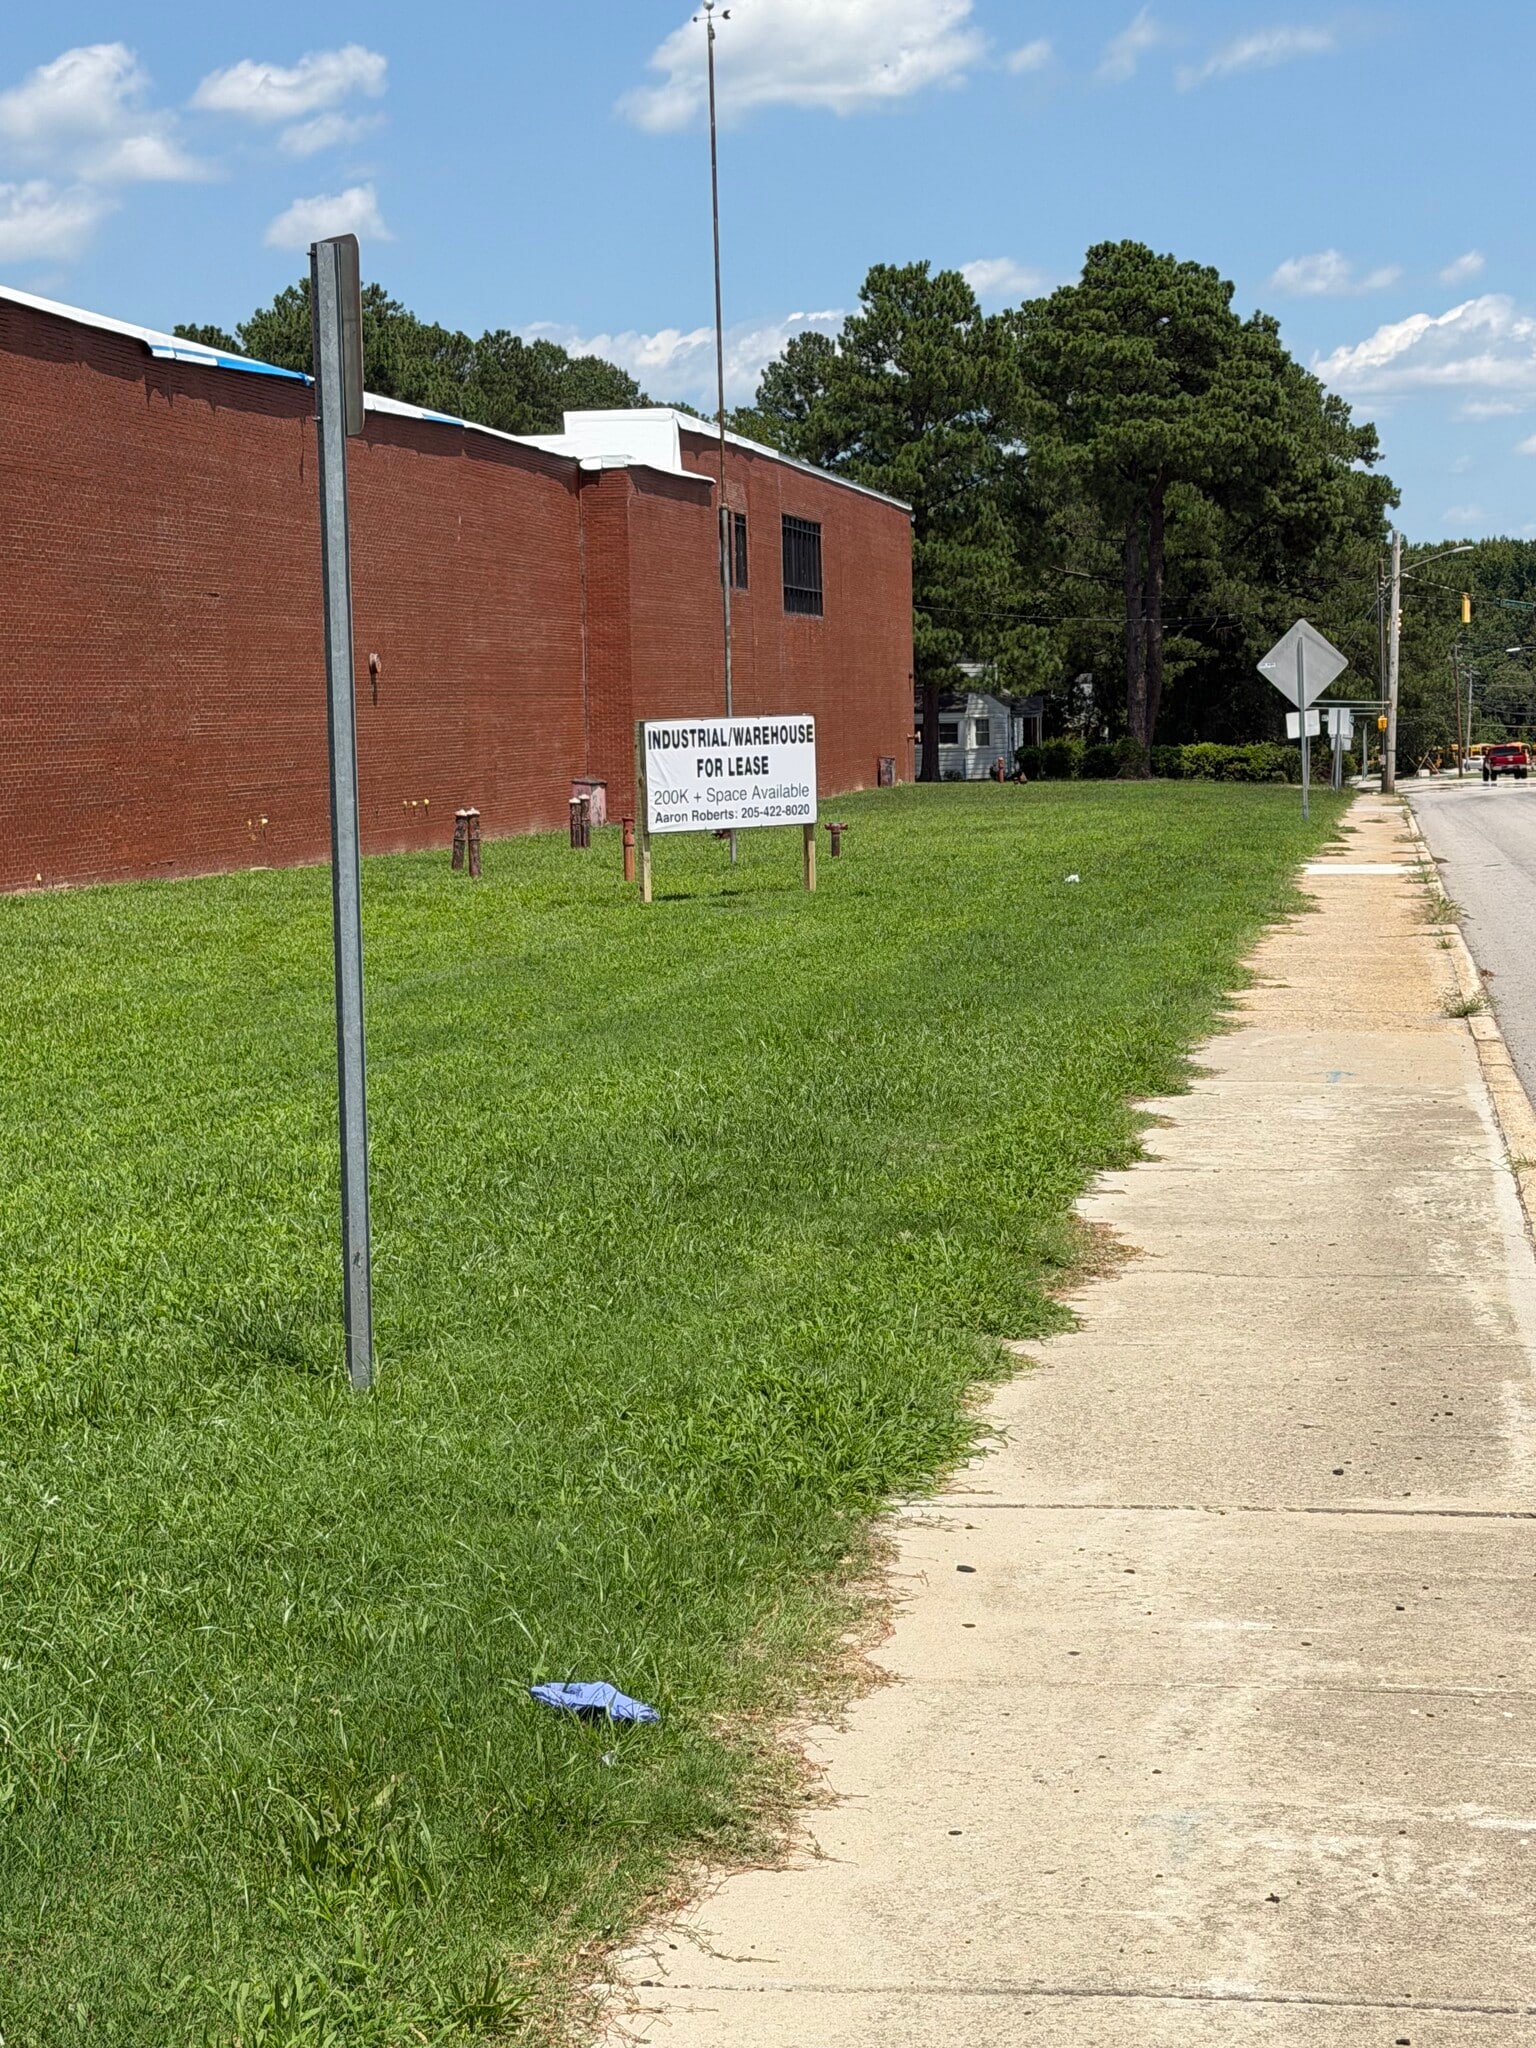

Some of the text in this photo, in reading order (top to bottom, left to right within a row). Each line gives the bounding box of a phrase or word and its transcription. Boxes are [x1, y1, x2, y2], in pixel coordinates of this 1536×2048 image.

[648, 724, 814, 750] INDUSTRIAL/WAREHOUSE
[697, 756, 769, 778] FOR LEASE
[654, 783, 810, 805] 200K + Space Available
[655, 804, 810, 824] Aaron Roberts: 205-422-8020
